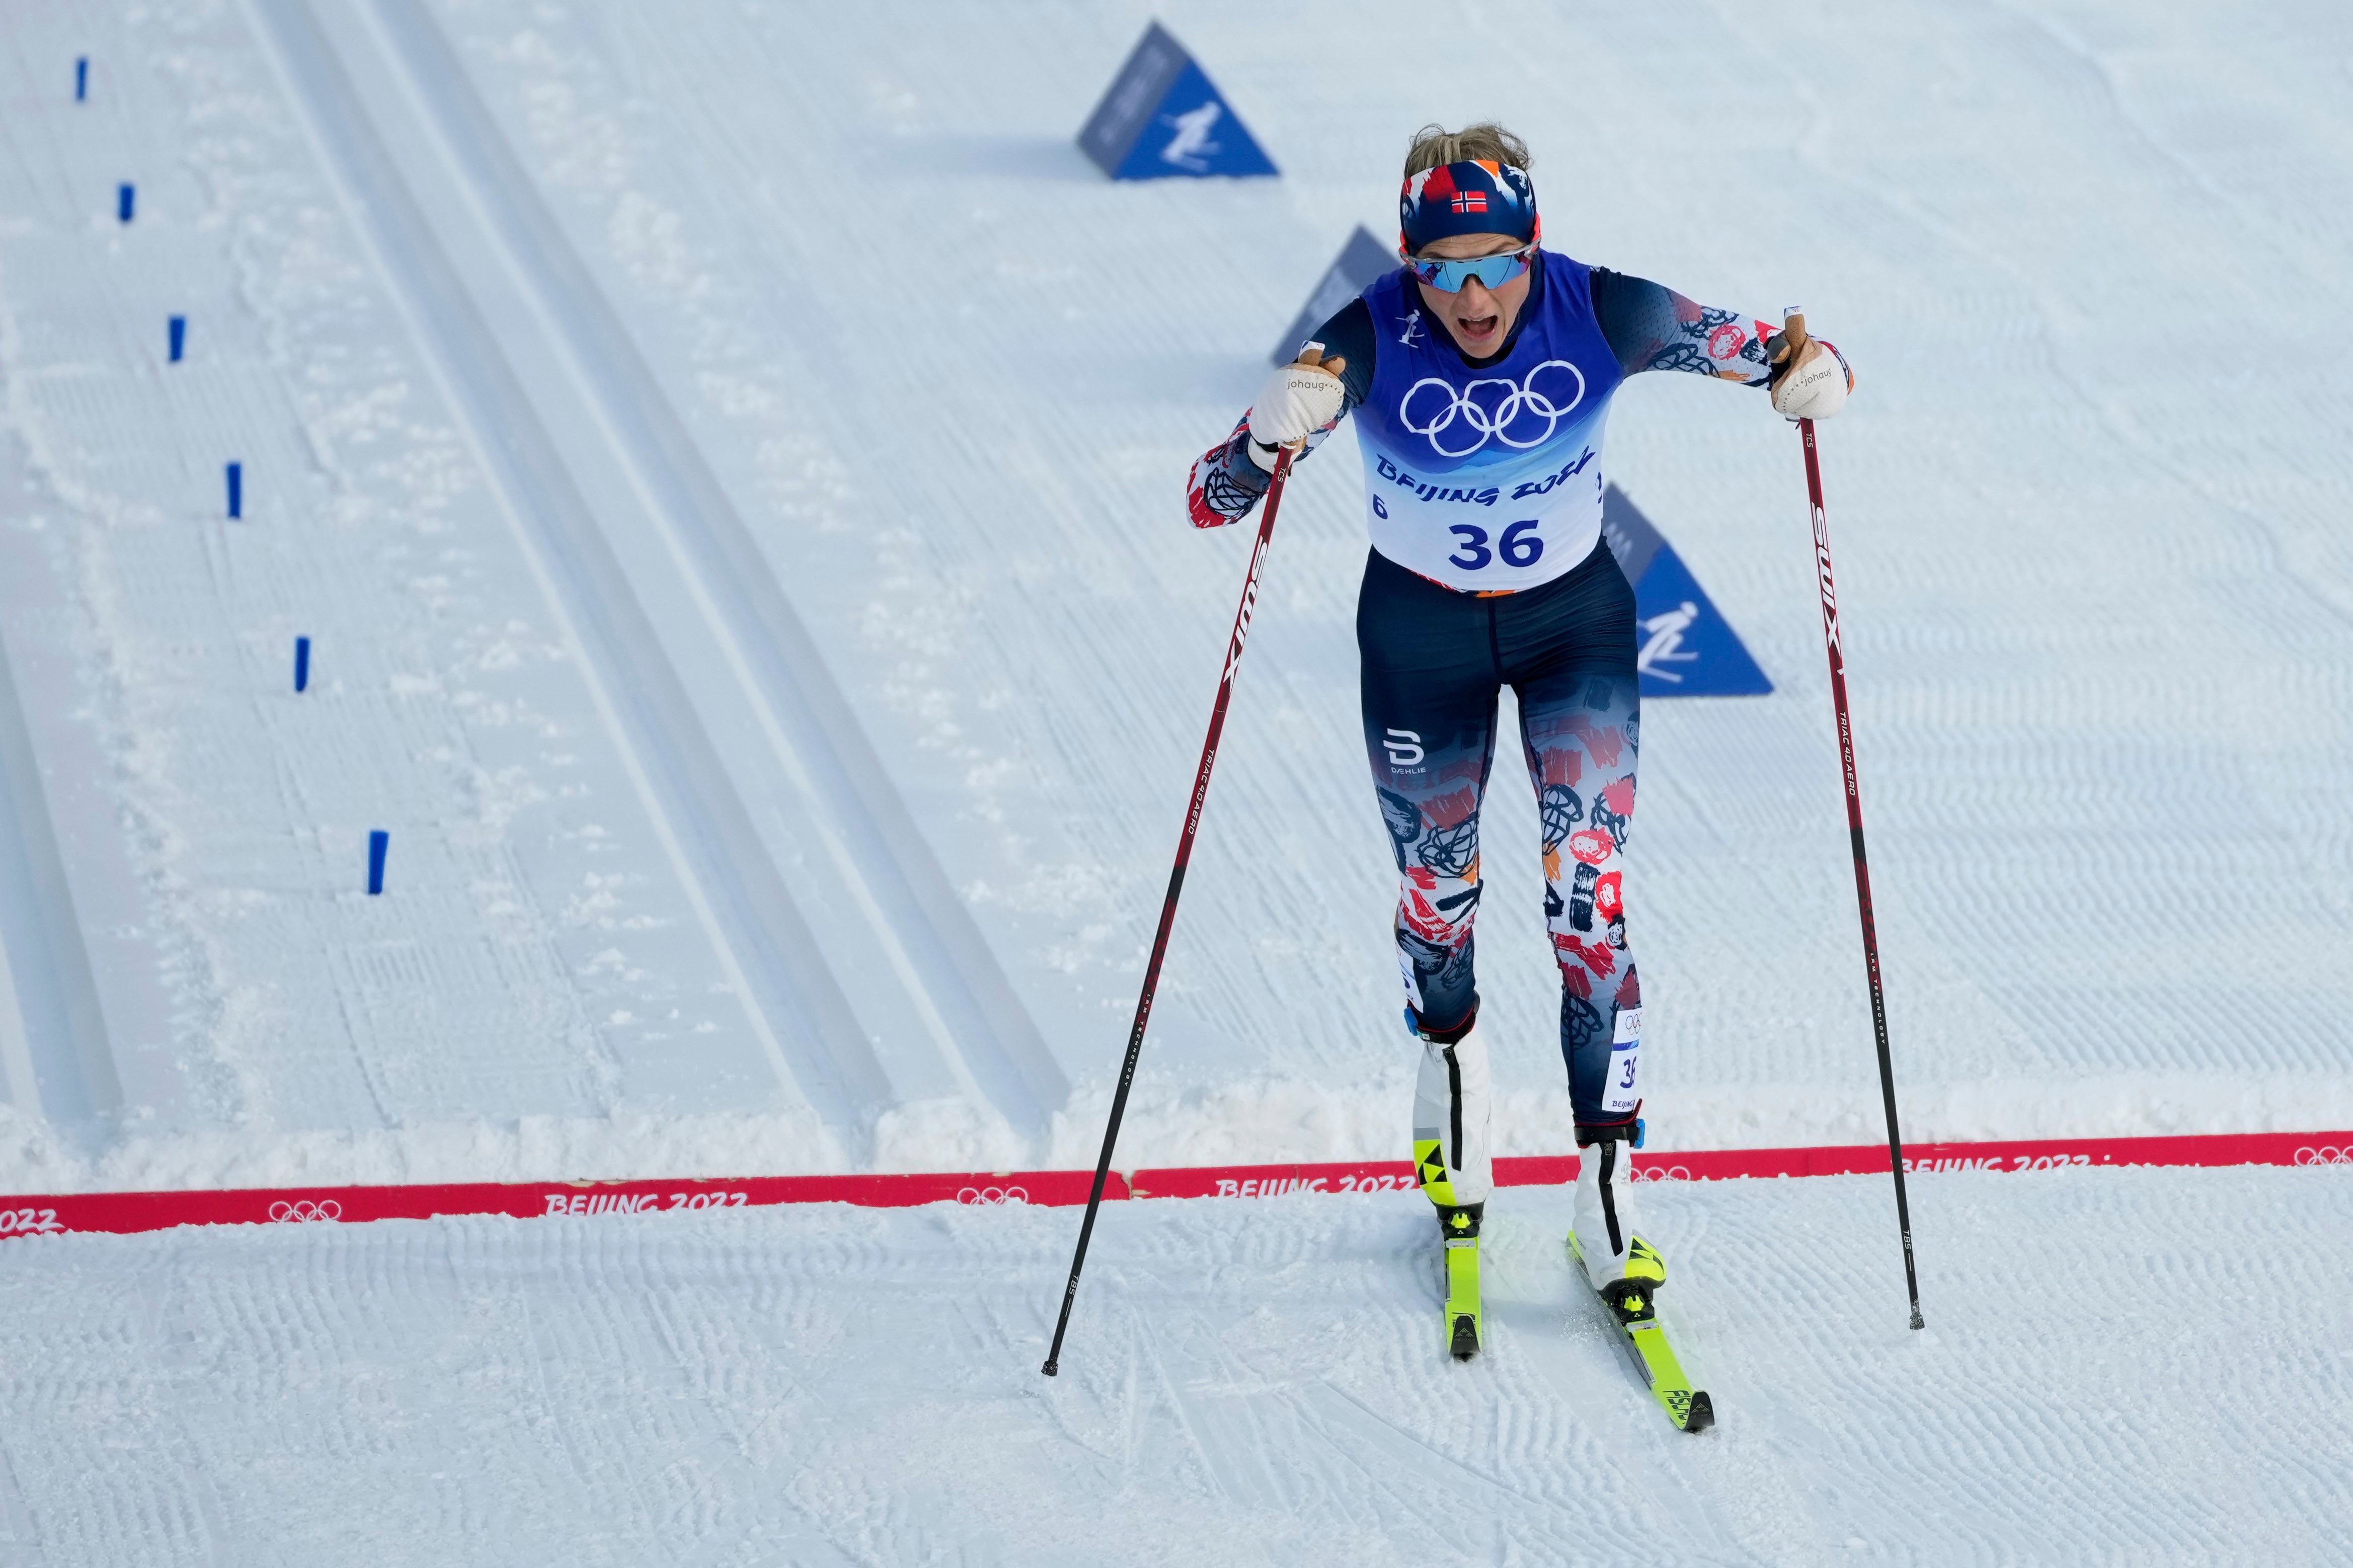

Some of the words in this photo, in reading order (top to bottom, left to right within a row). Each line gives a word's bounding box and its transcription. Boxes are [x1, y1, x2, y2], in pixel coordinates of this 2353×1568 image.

[1287, 379, 1324, 391] johaug
[1804, 368, 1831, 387] johaug
[1806, 433, 1814, 448] TCS
[1278, 467, 1286, 483] TCS
[1376, 453, 1500, 506] BEIJING
[1448, 520, 1543, 570] 36
[1811, 501, 1841, 657] SWIX
[1223, 535, 1268, 697] SWIX
[1201, 749, 1214, 784] TRIAC
[1840, 711, 1850, 746] TRIAC
[1846, 764, 1856, 796] AERO
[1188, 801, 1200, 835] AERO
[1873, 979, 1885, 1044] TECHNOLOGY
[1125, 1021, 1144, 1087] TECHNOLOGY
[670, 1192, 747, 1210] 2022
